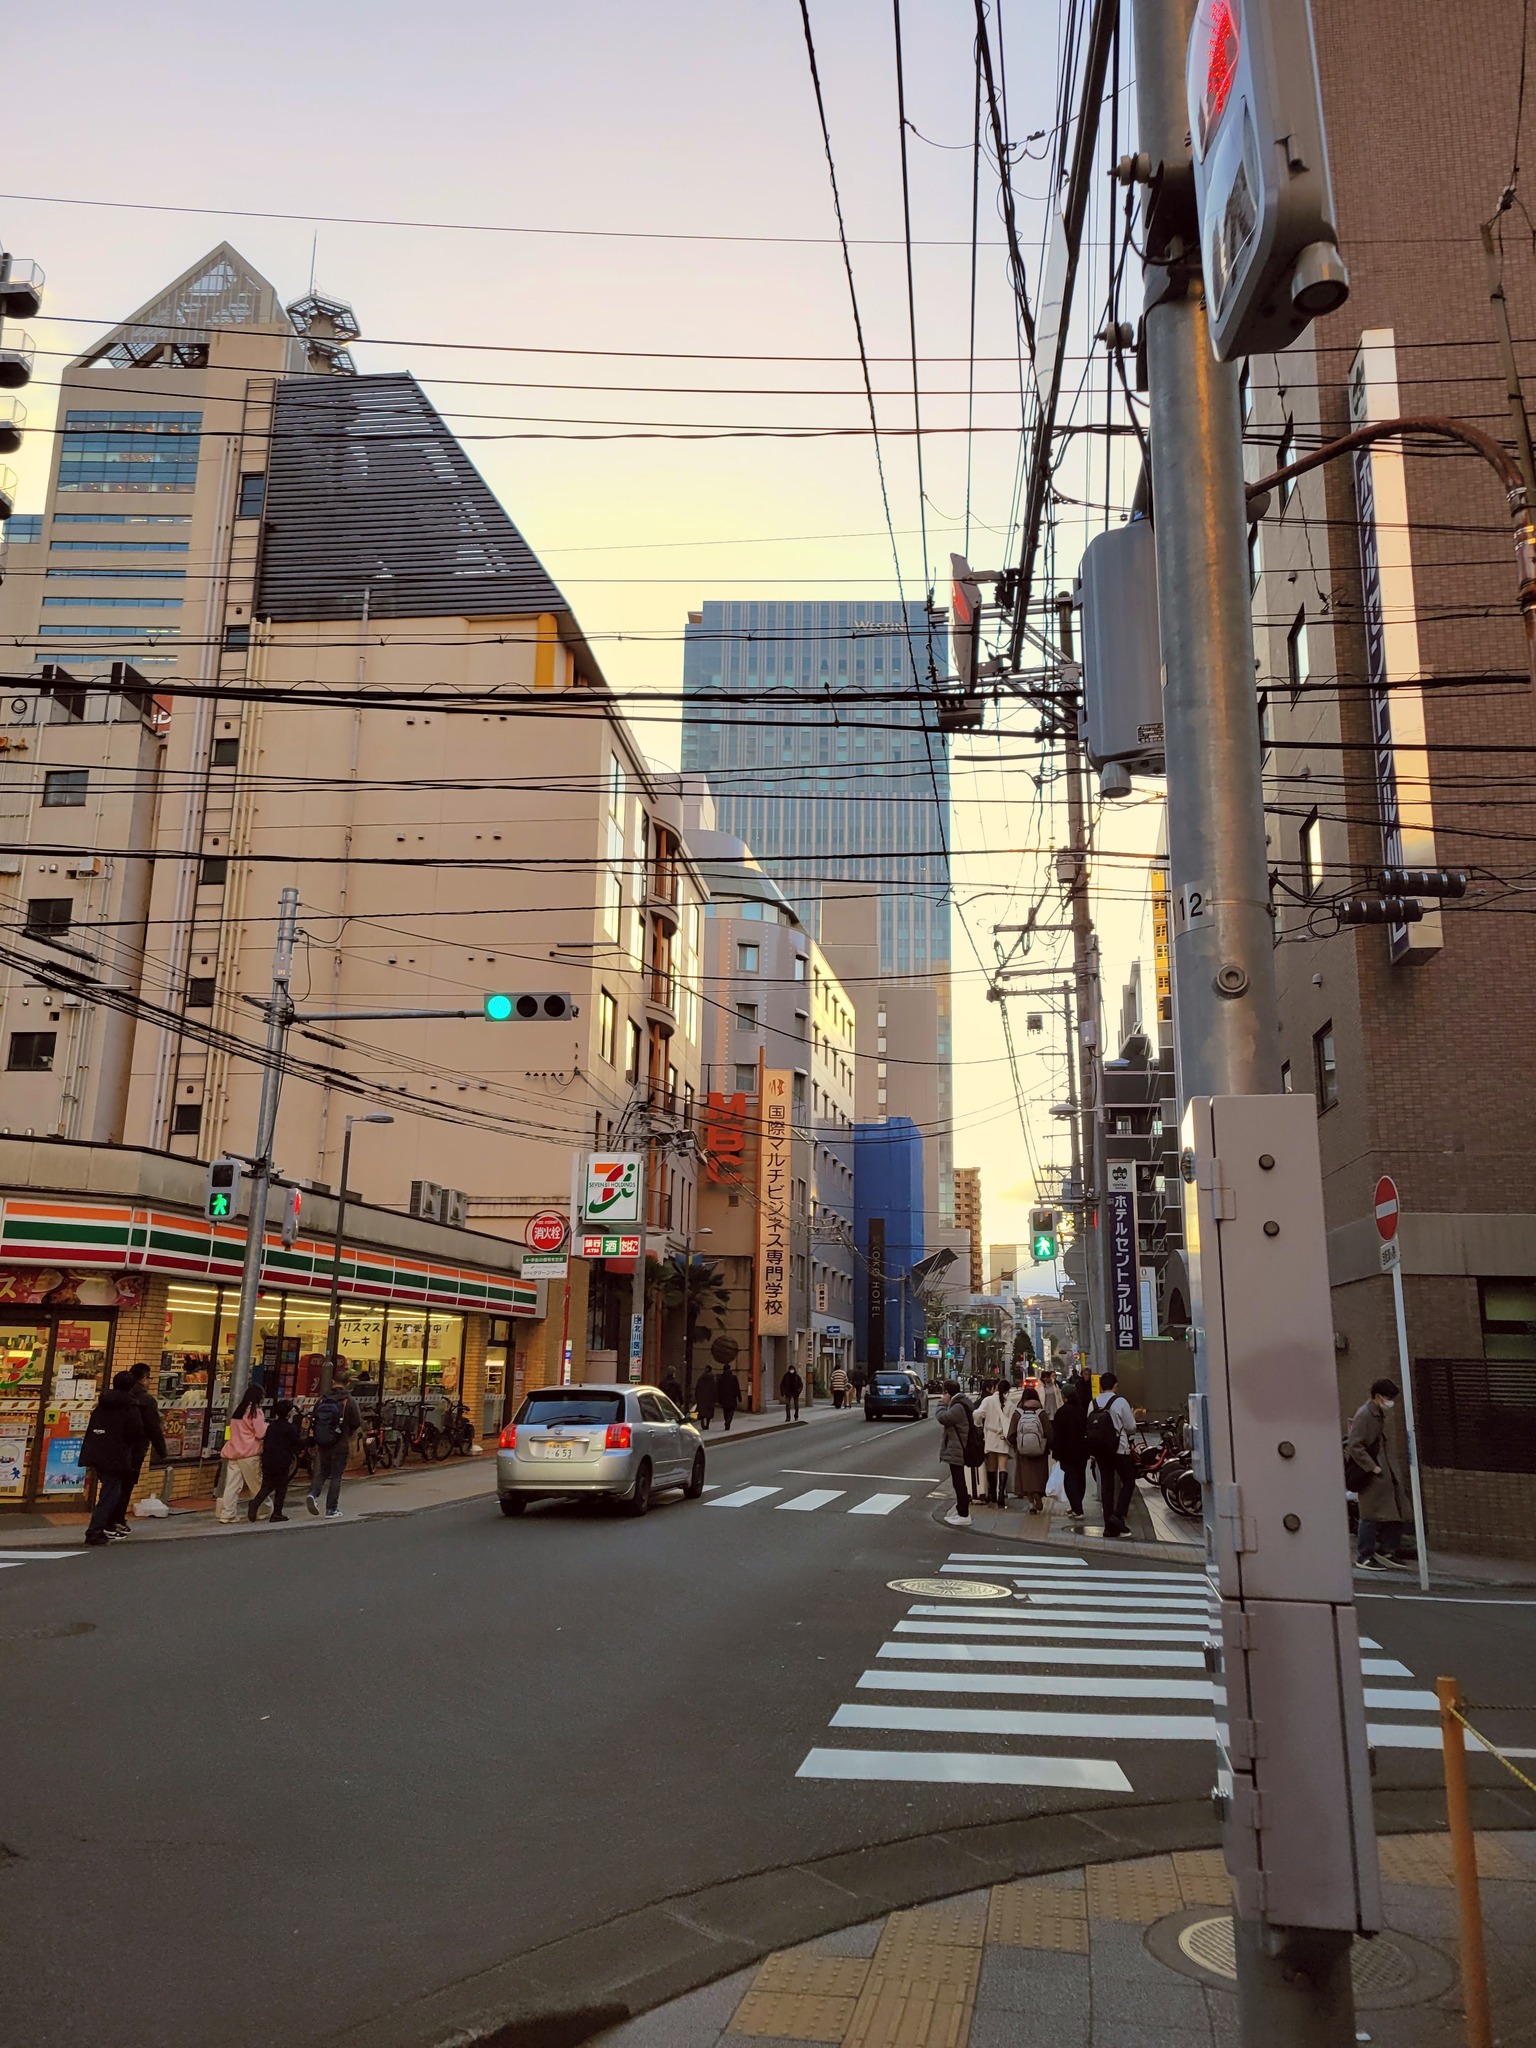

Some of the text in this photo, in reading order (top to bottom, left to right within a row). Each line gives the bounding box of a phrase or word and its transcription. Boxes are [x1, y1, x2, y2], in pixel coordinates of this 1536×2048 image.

[706, 1092, 746, 1184] MBC
[765, 1104, 786, 1315] 国際マルチビジネス専門学校
[534, 1226, 561, 1240] 消火栓
[584, 1240, 601, 1248] 銀行
[605, 1240, 617, 1253] 酒
[621, 1240, 638, 1252] たばこ
[1114, 1194, 1134, 1348] ホテルセントラル仙台
[871, 1281, 881, 1318] HOTEL
[339, 1322, 381, 1333] リスマス
[341, 1336, 371, 1347] ケーキ
